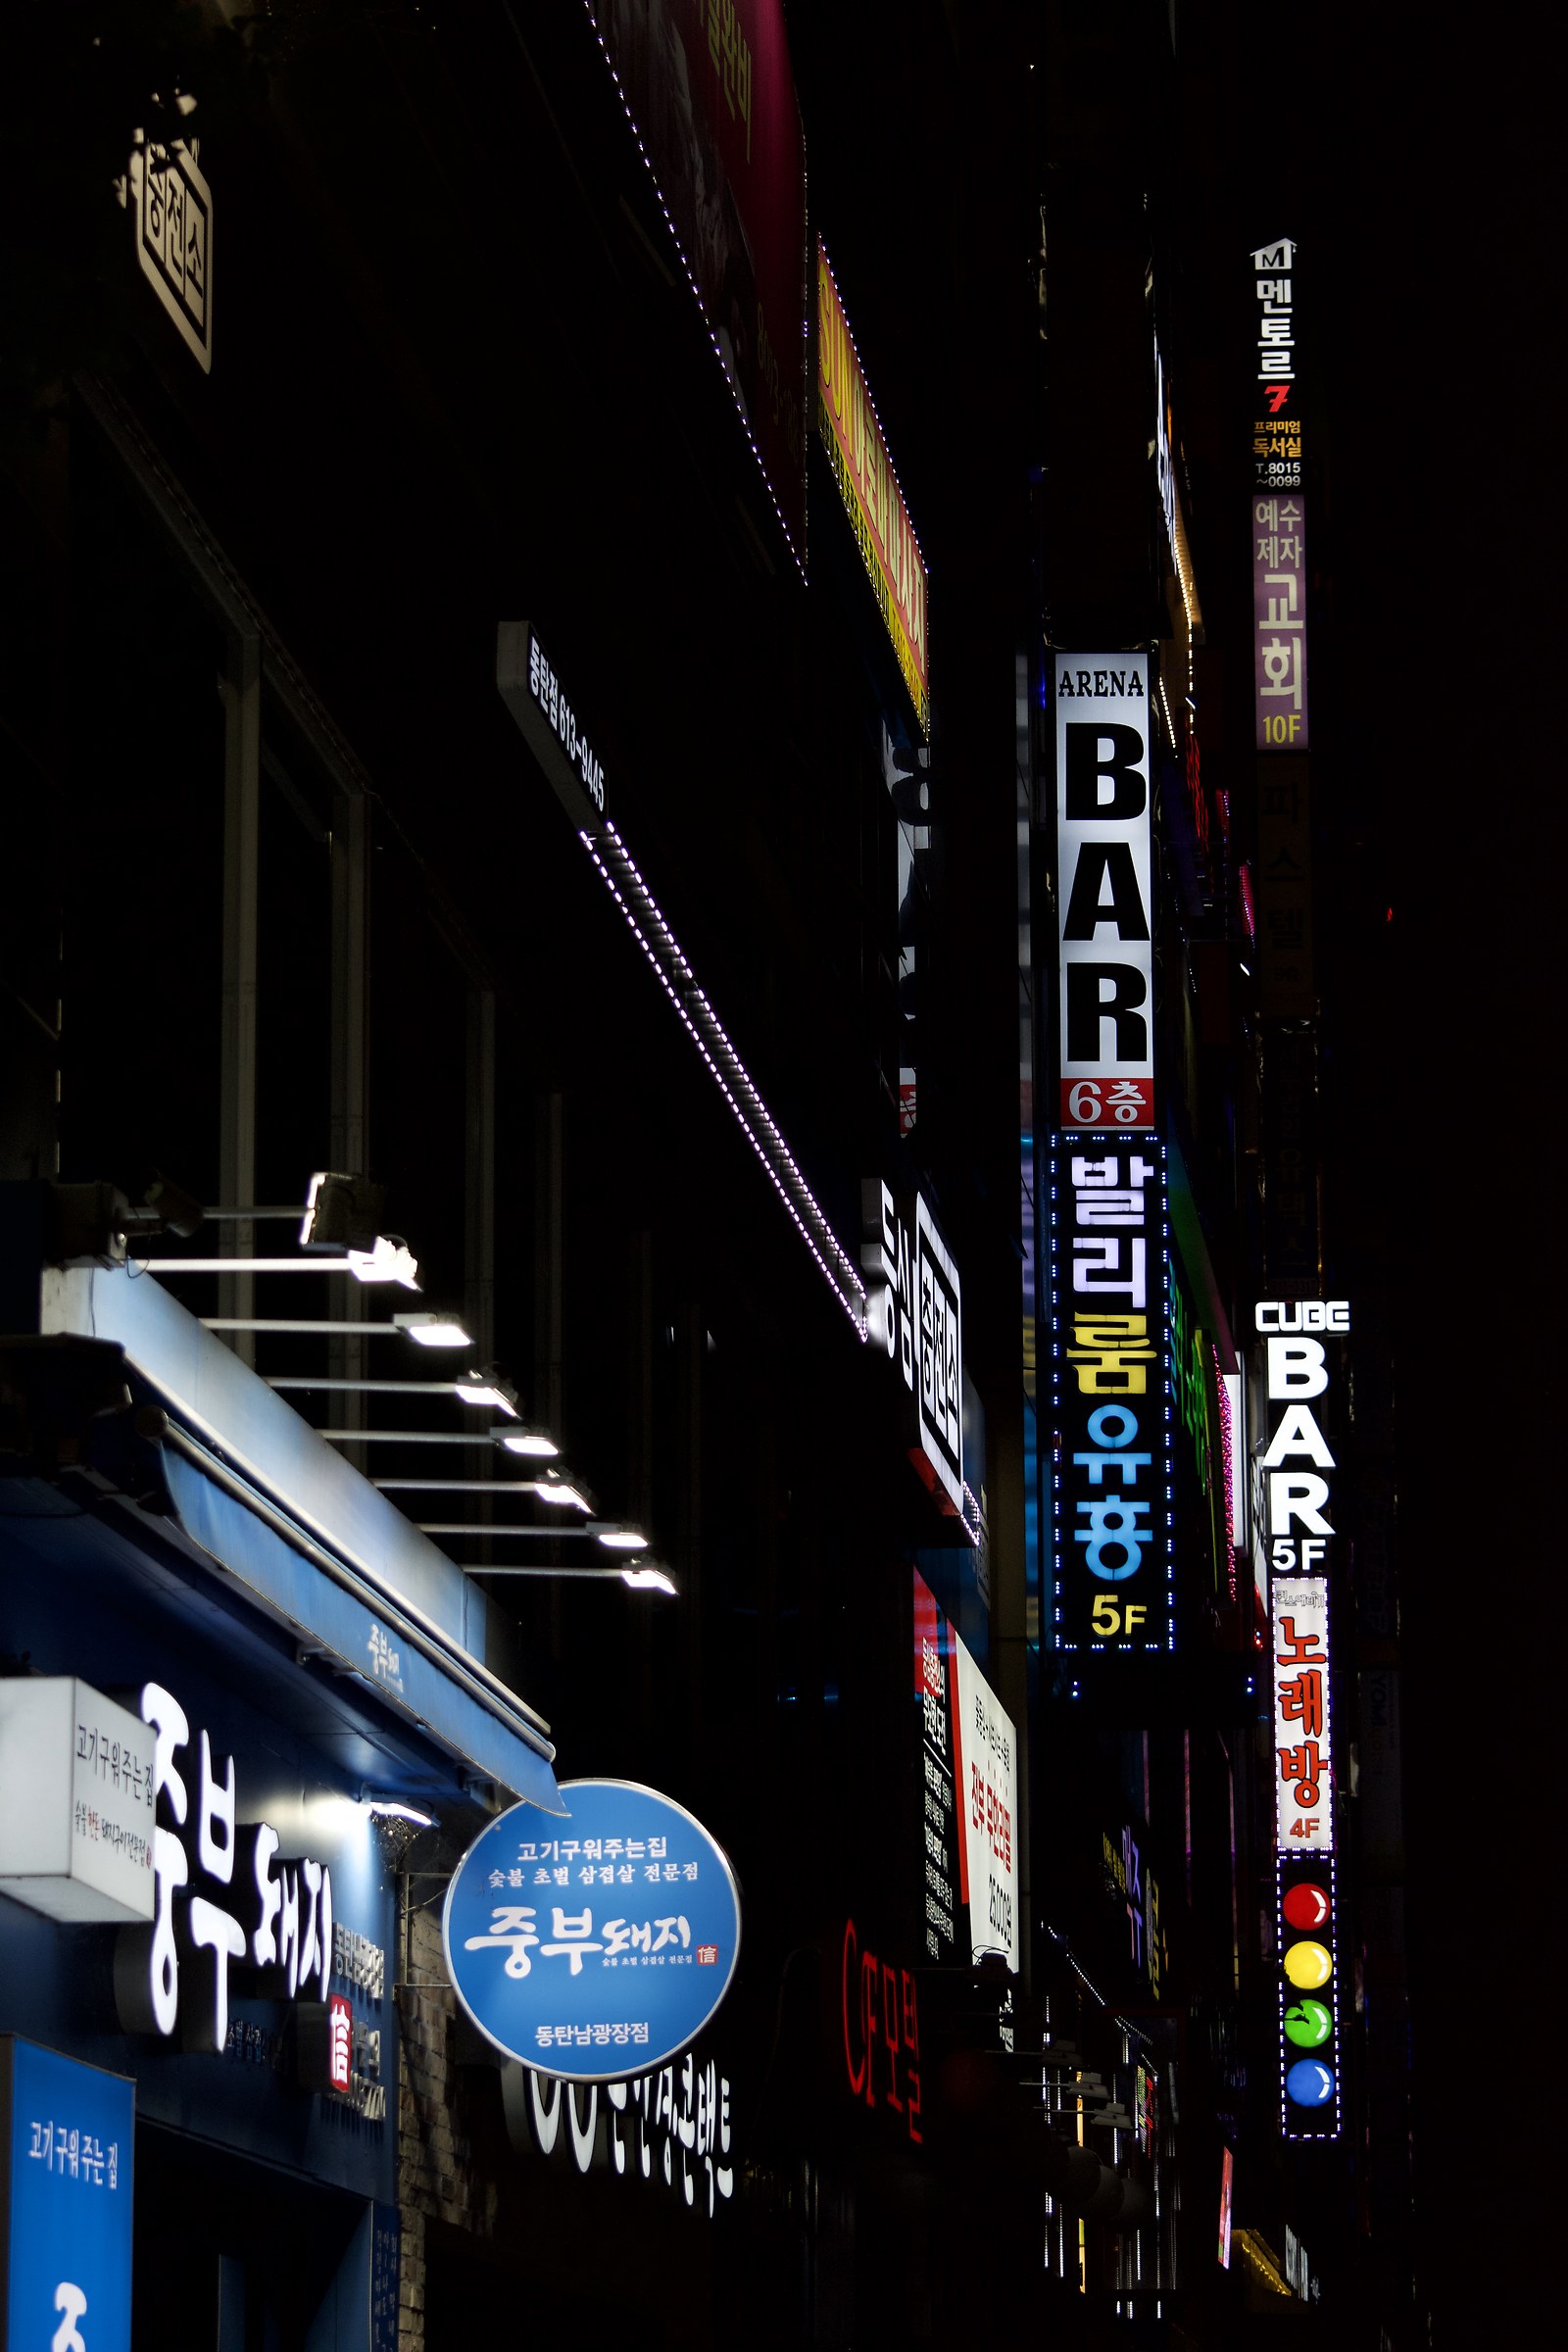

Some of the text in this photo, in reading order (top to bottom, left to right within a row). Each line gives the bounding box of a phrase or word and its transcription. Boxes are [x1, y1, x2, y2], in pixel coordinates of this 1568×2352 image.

[1256, 278, 1296, 380] 멘토르
[1263, 384, 1292, 414] 7
[1253, 420, 1301, 435] 프리미엄
[1252, 437, 1302, 459] 독서실
[1254, 462, 1301, 474] T.8015
[1255, 499, 1302, 532] 예수
[1256, 535, 1302, 569] 제자
[1258, 573, 1304, 710] 교회
[1058, 670, 1145, 699] ARENA
[530, 635, 605, 813] 동탄점 613-9445
[1262, 713, 1301, 745] 10F
[1062, 721, 1152, 1063] BAR
[1067, 1080, 1147, 1124] 6층
[881, 1179, 913, 1392] 등심
[921, 1276, 957, 1423] 충전소
[1255, 1300, 1350, 1333] CUBE
[1262, 1337, 1337, 1536] BAR
[1271, 1539, 1327, 1571] 5F
[1091, 1593, 1148, 1638] 5F
[1276, 1616, 1330, 1809] 노래방
[1289, 1817, 1321, 1839] 4F
[516, 1836, 668, 1862] 고기구워주는집
[141, 1682, 333, 2055] 중부돼지
[488, 1861, 700, 1888] 숯불 초벌 삼겹살 전문점
[464, 1905, 692, 1980] 중부돼지
[697, 1945, 718, 1966] 信
[535, 2022, 651, 2047] 동탄남광장점
